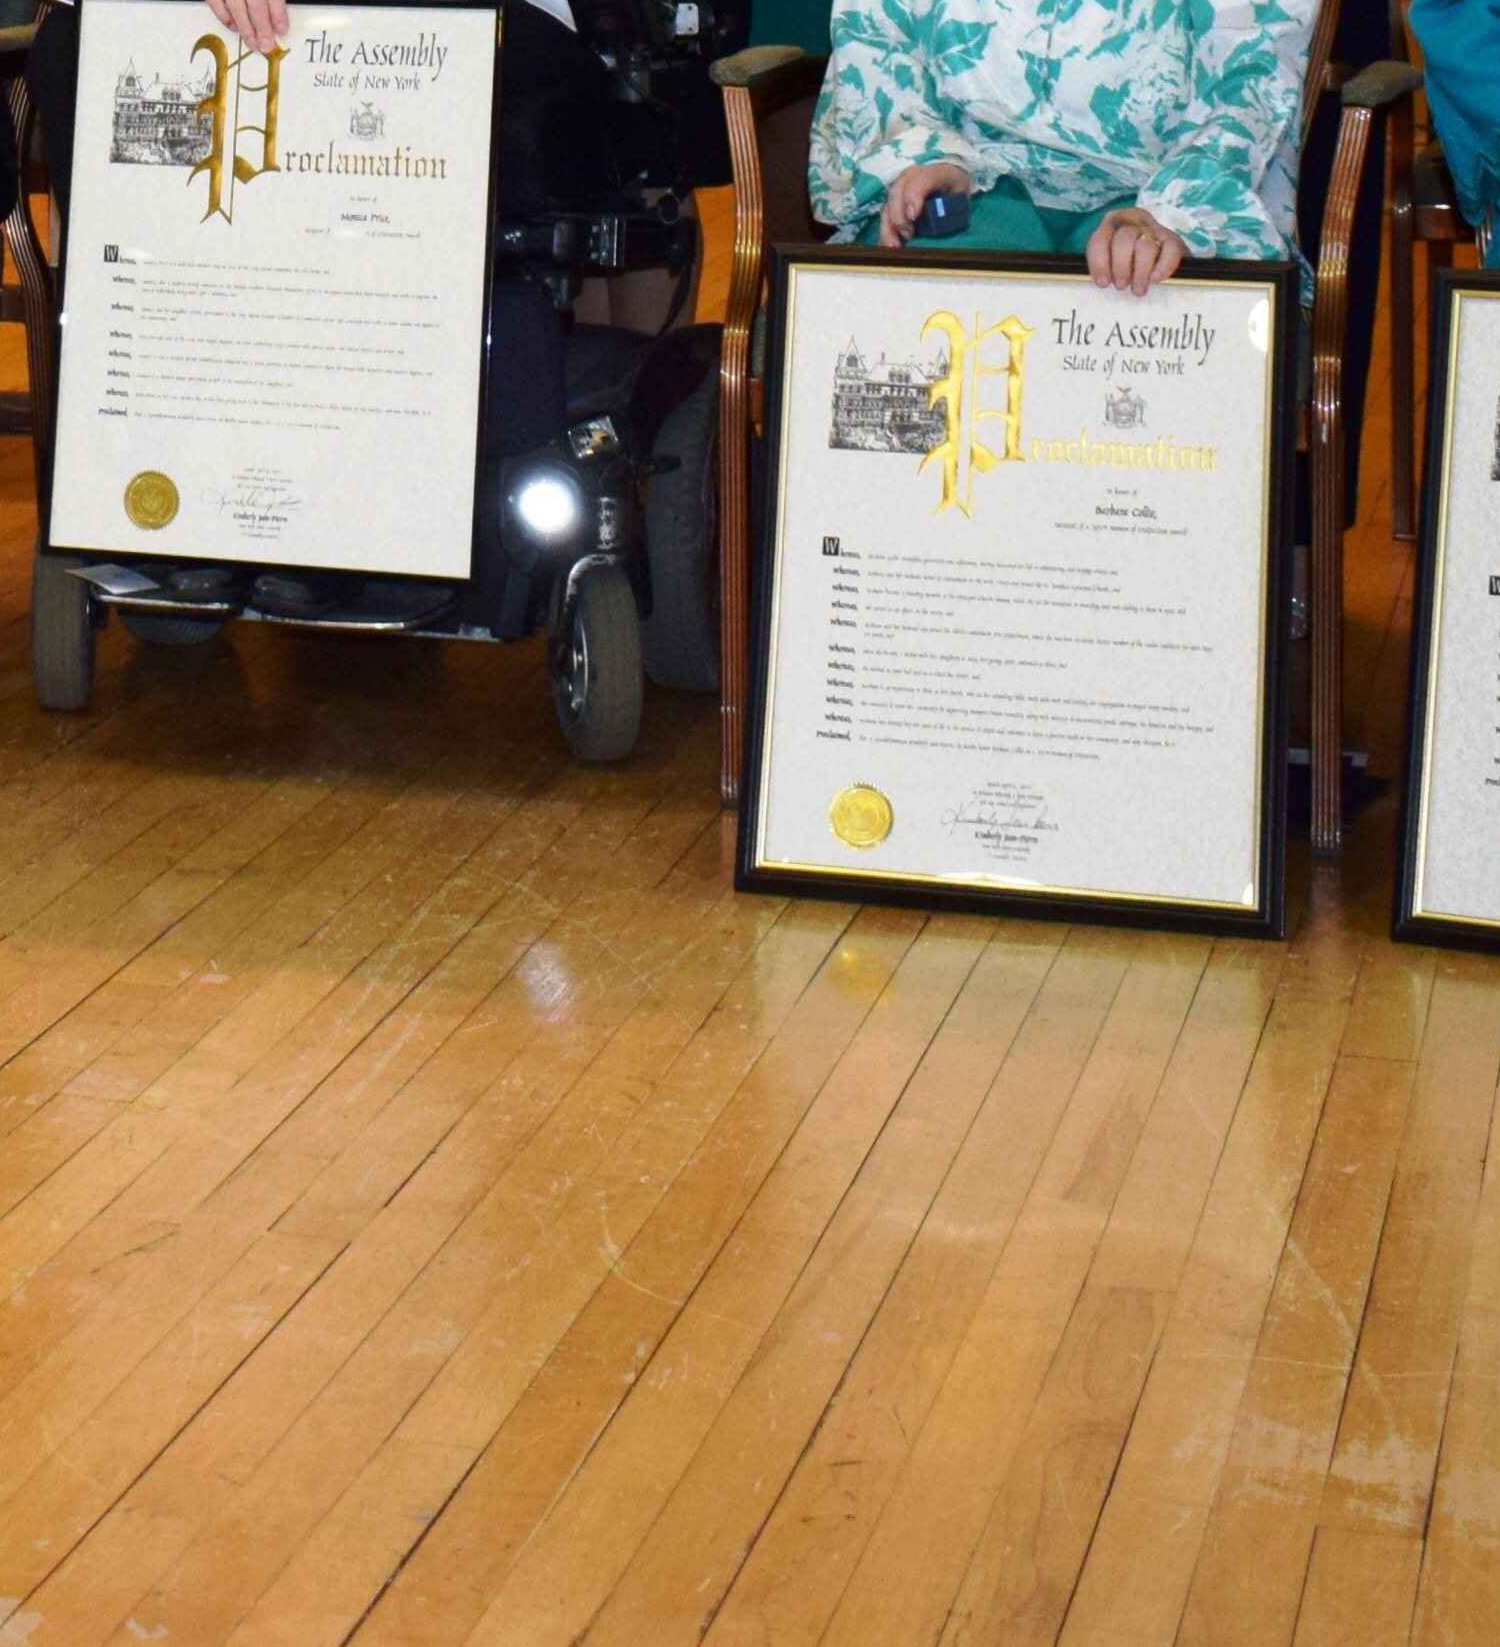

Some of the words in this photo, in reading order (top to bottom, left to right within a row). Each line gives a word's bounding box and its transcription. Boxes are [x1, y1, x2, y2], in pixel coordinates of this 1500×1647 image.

[305, 30, 344, 65] The
[352, 33, 448, 82] Assembly
[314, 72, 344, 89] State
[349, 70, 361, 95] of
[365, 74, 391, 90] New
[395, 73, 421, 91] York
[186, 34, 448, 226] Proclamation
[1052, 309, 1095, 346] The
[1105, 314, 1216, 366] Assembly
[1063, 354, 1098, 372] State
[1103, 352, 1117, 379] of
[1121, 358, 1150, 374] New
[1155, 356, 1185, 376] York
[917, 310, 1218, 519] Proclamation
